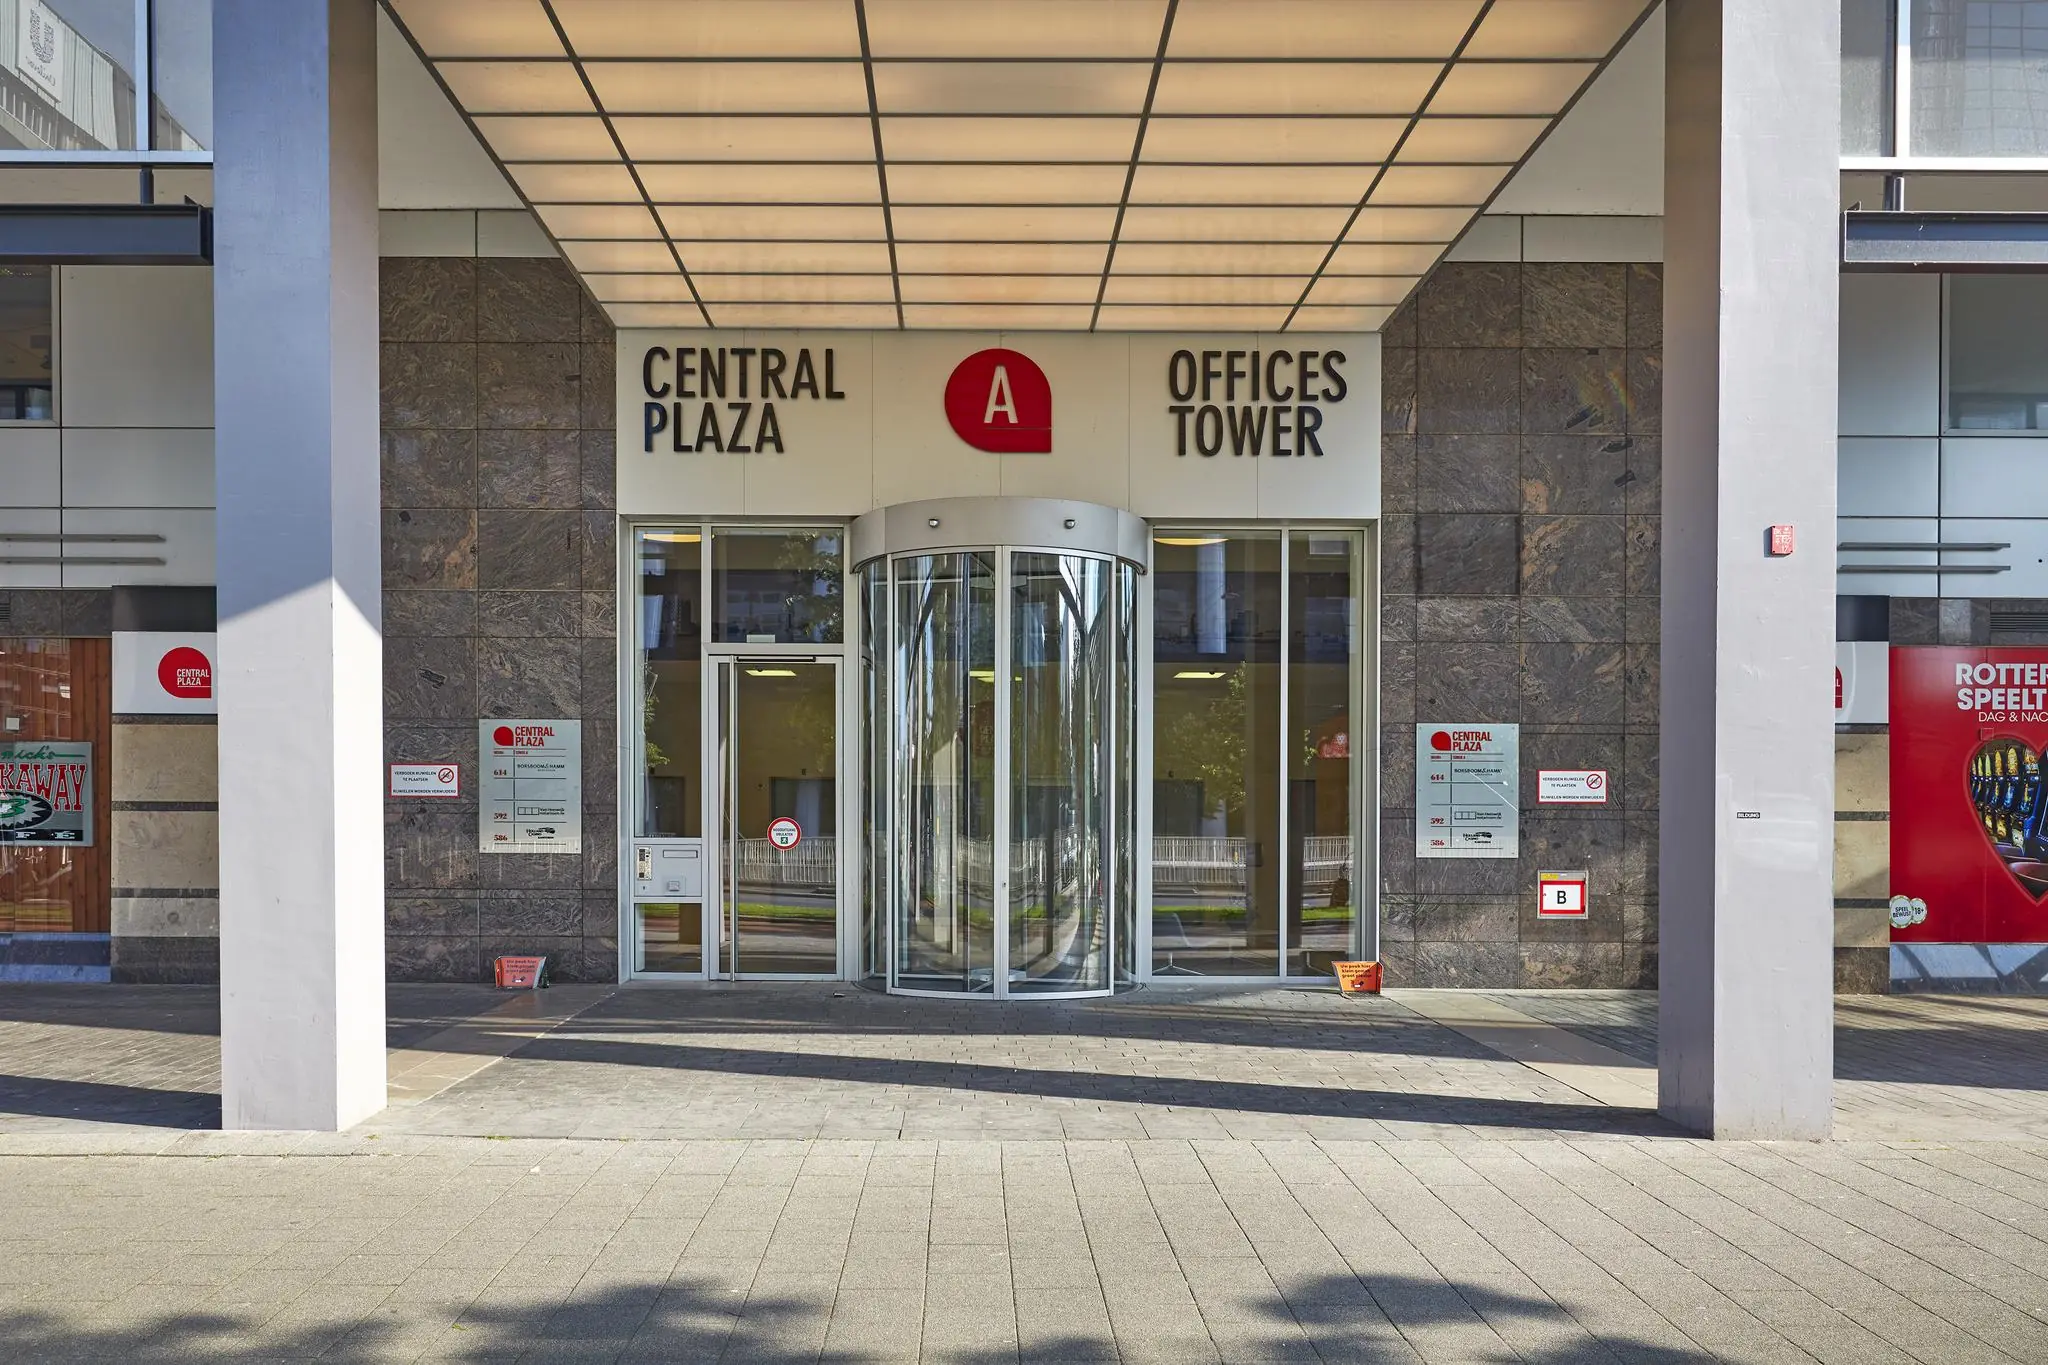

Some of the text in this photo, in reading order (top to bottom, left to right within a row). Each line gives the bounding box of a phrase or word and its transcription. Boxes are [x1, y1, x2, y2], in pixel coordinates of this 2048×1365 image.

[643, 346, 846, 399] CENTRAL
[1169, 349, 1348, 403] OFFICES
[983, 364, 1019, 424] A
[644, 402, 785, 453] PLAZA
[1169, 404, 1324, 457] TOWER
[176, 668, 210, 678] CENTRAL
[177, 677, 201, 686] PLAZA
[1957, 687, 2048, 711] SPEELT
[1978, 711, 2006, 723] DAG
[2009, 711, 2018, 723] &
[515, 726, 555, 737] CENTRAL
[1452, 731, 1493, 741] CENTRAL
[515, 736, 545, 747] PLAZA
[1453, 741, 1482, 751] PLAZA
[493, 812, 507, 820] 592
[1430, 817, 1445, 825] 592
[1557, 890, 1567, 904] B
